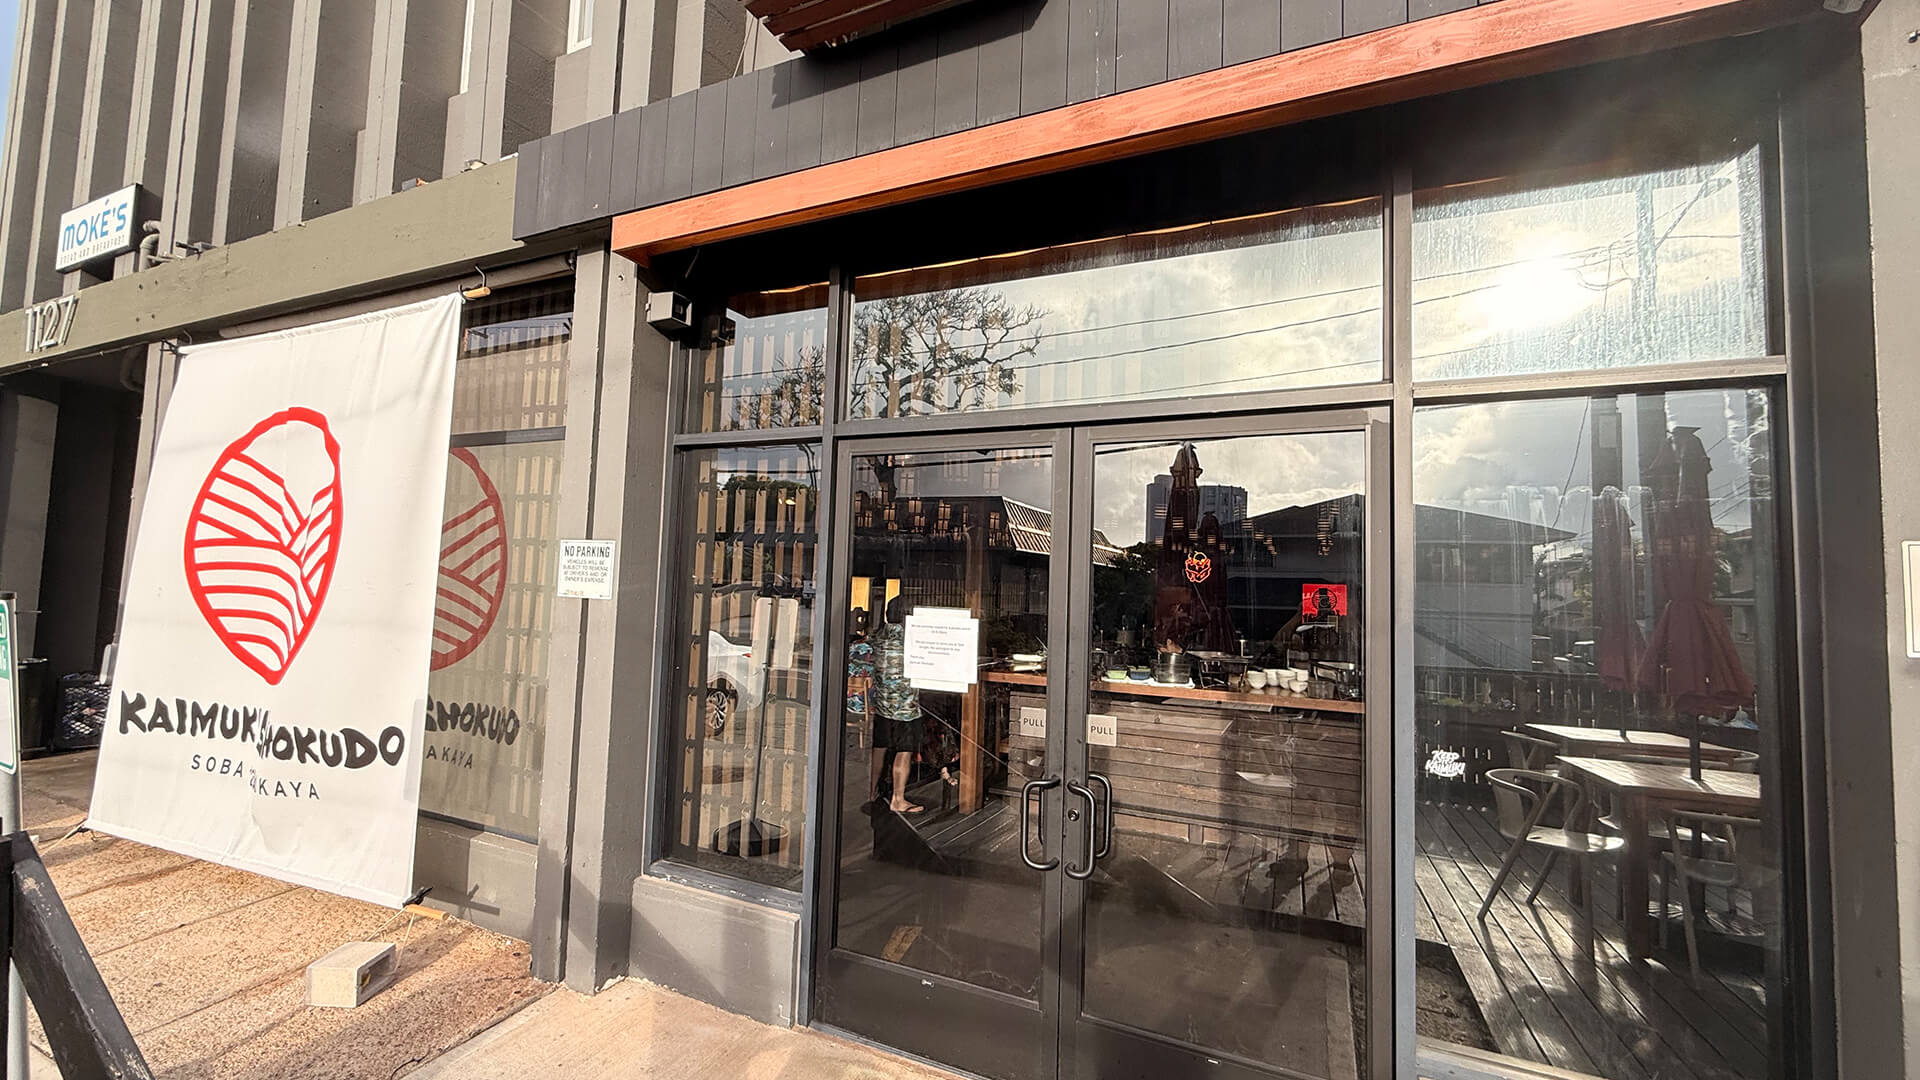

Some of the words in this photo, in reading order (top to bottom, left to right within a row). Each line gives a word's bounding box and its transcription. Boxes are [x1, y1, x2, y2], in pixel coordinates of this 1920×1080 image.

[25, 295, 78, 352] 1127
[564, 546, 575, 557] NO
[576, 546, 611, 558] PARKING
[119, 690, 261, 742] KAIMUK
[1023, 717, 1045, 728] PULL
[1090, 725, 1114, 736] PULL
[191, 754, 244, 778] SOBA
